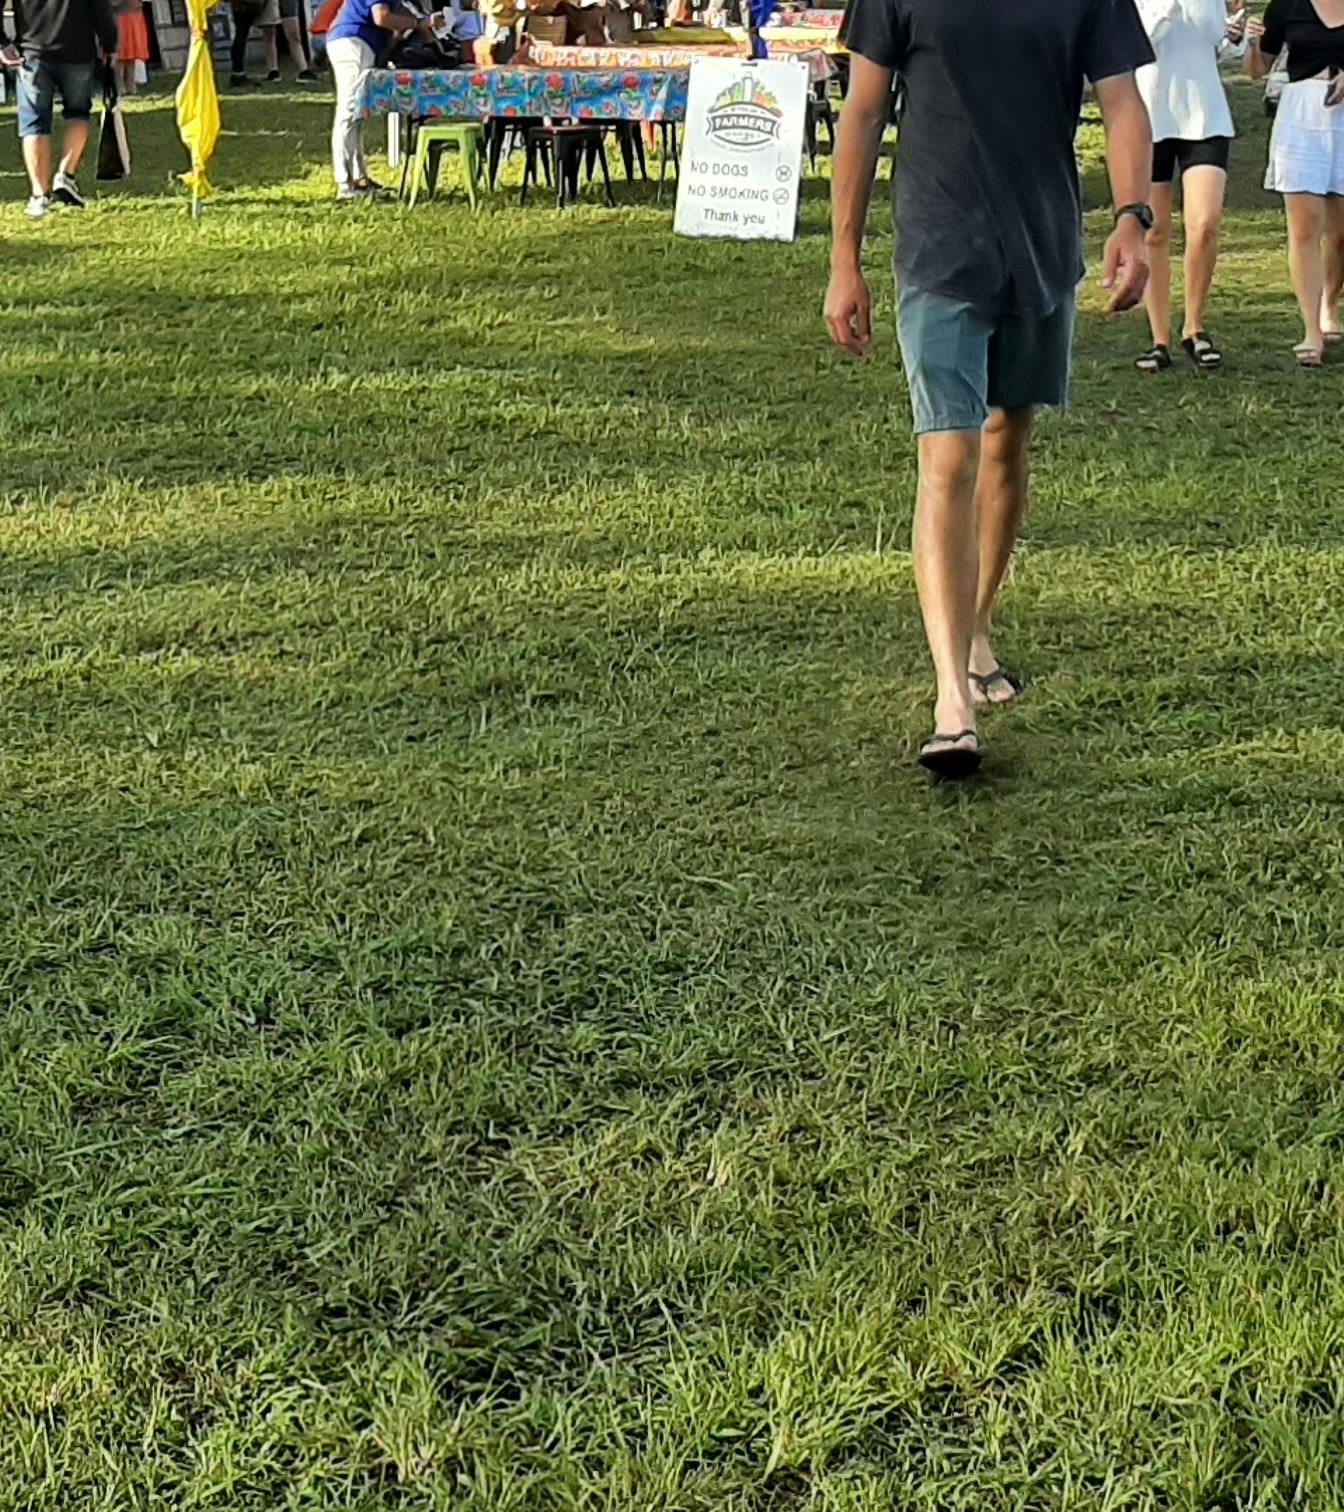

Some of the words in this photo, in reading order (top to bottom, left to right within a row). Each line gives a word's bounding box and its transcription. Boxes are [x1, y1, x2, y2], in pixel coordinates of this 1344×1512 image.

[714, 115, 774, 132] FARMERS
[690, 160, 709, 175] NO
[712, 163, 749, 177] DOGS
[688, 184, 706, 198] NO
[709, 185, 769, 202] SMOKING
[703, 208, 739, 223] Thank
[743, 213, 766, 226] you
